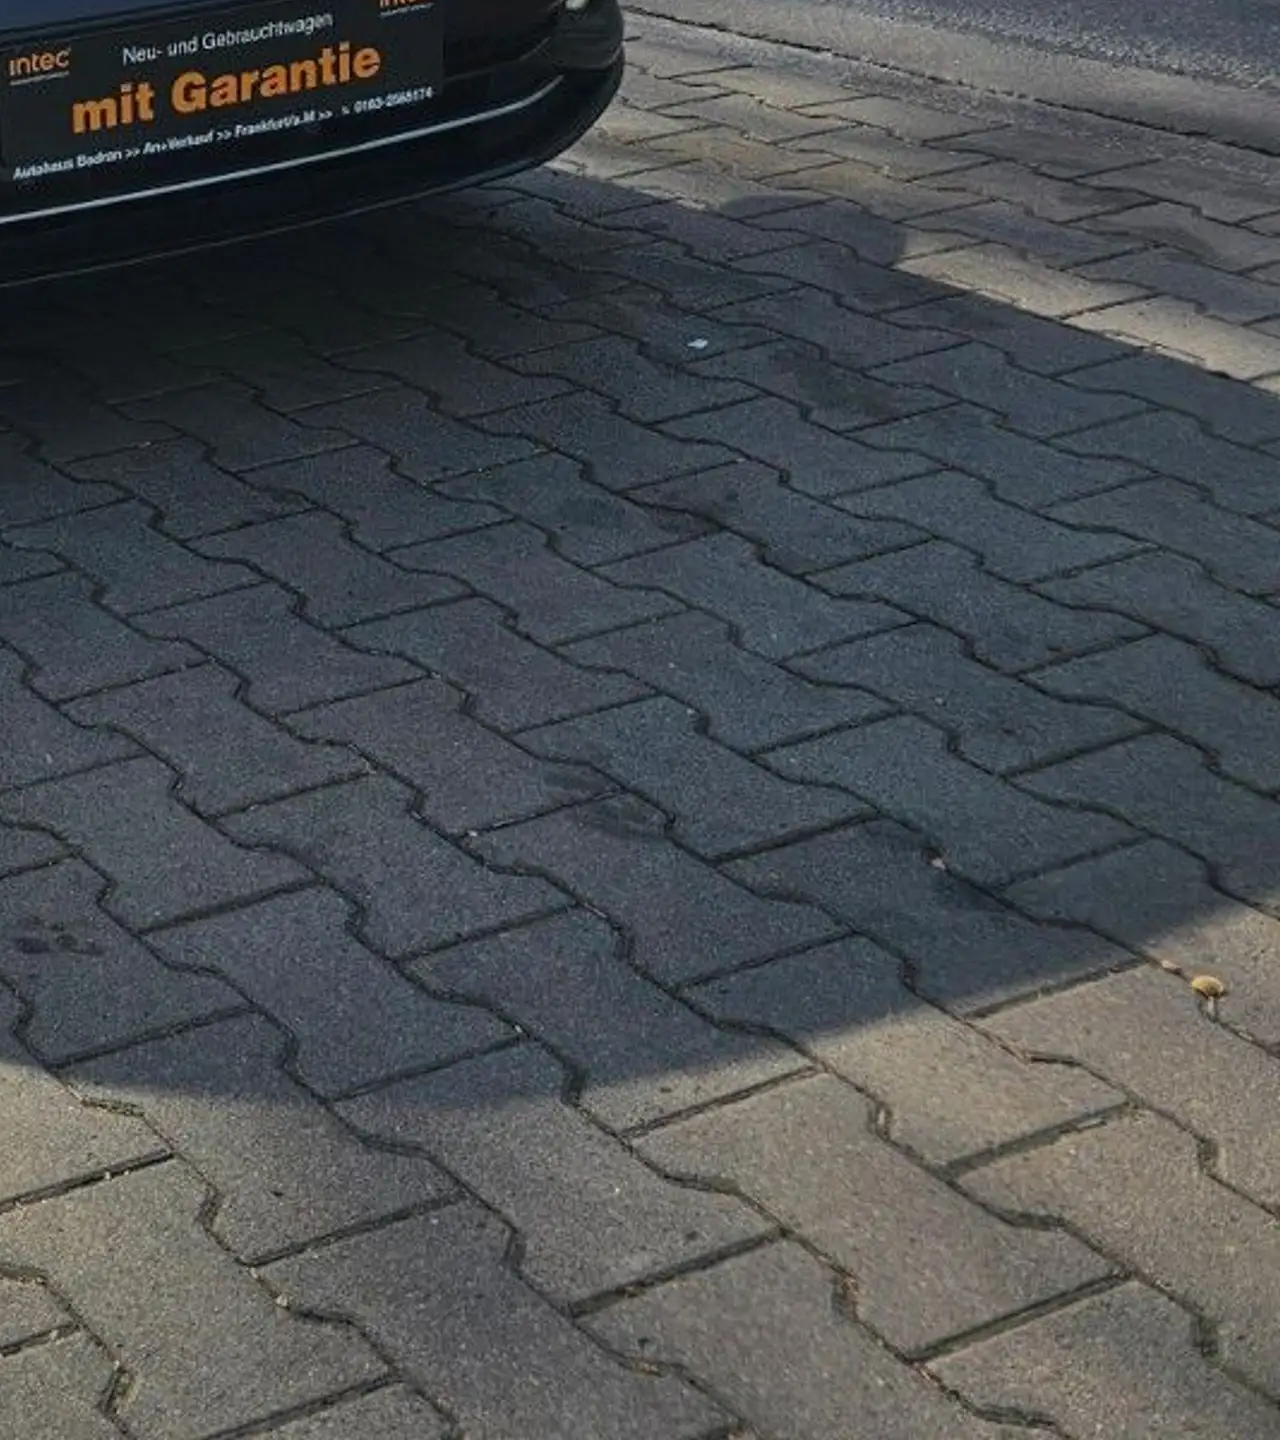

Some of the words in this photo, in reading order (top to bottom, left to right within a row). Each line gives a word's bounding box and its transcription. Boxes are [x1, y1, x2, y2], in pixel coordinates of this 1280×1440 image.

[122, 46, 163, 67] Neu-
[166, 35, 198, 57] und
[201, 12, 334, 50] Gebrauchtwagen
[8, 48, 71, 77] intec
[71, 81, 155, 135] mit
[171, 40, 382, 114] Garantie
[11, 158, 75, 182] Autohaus
